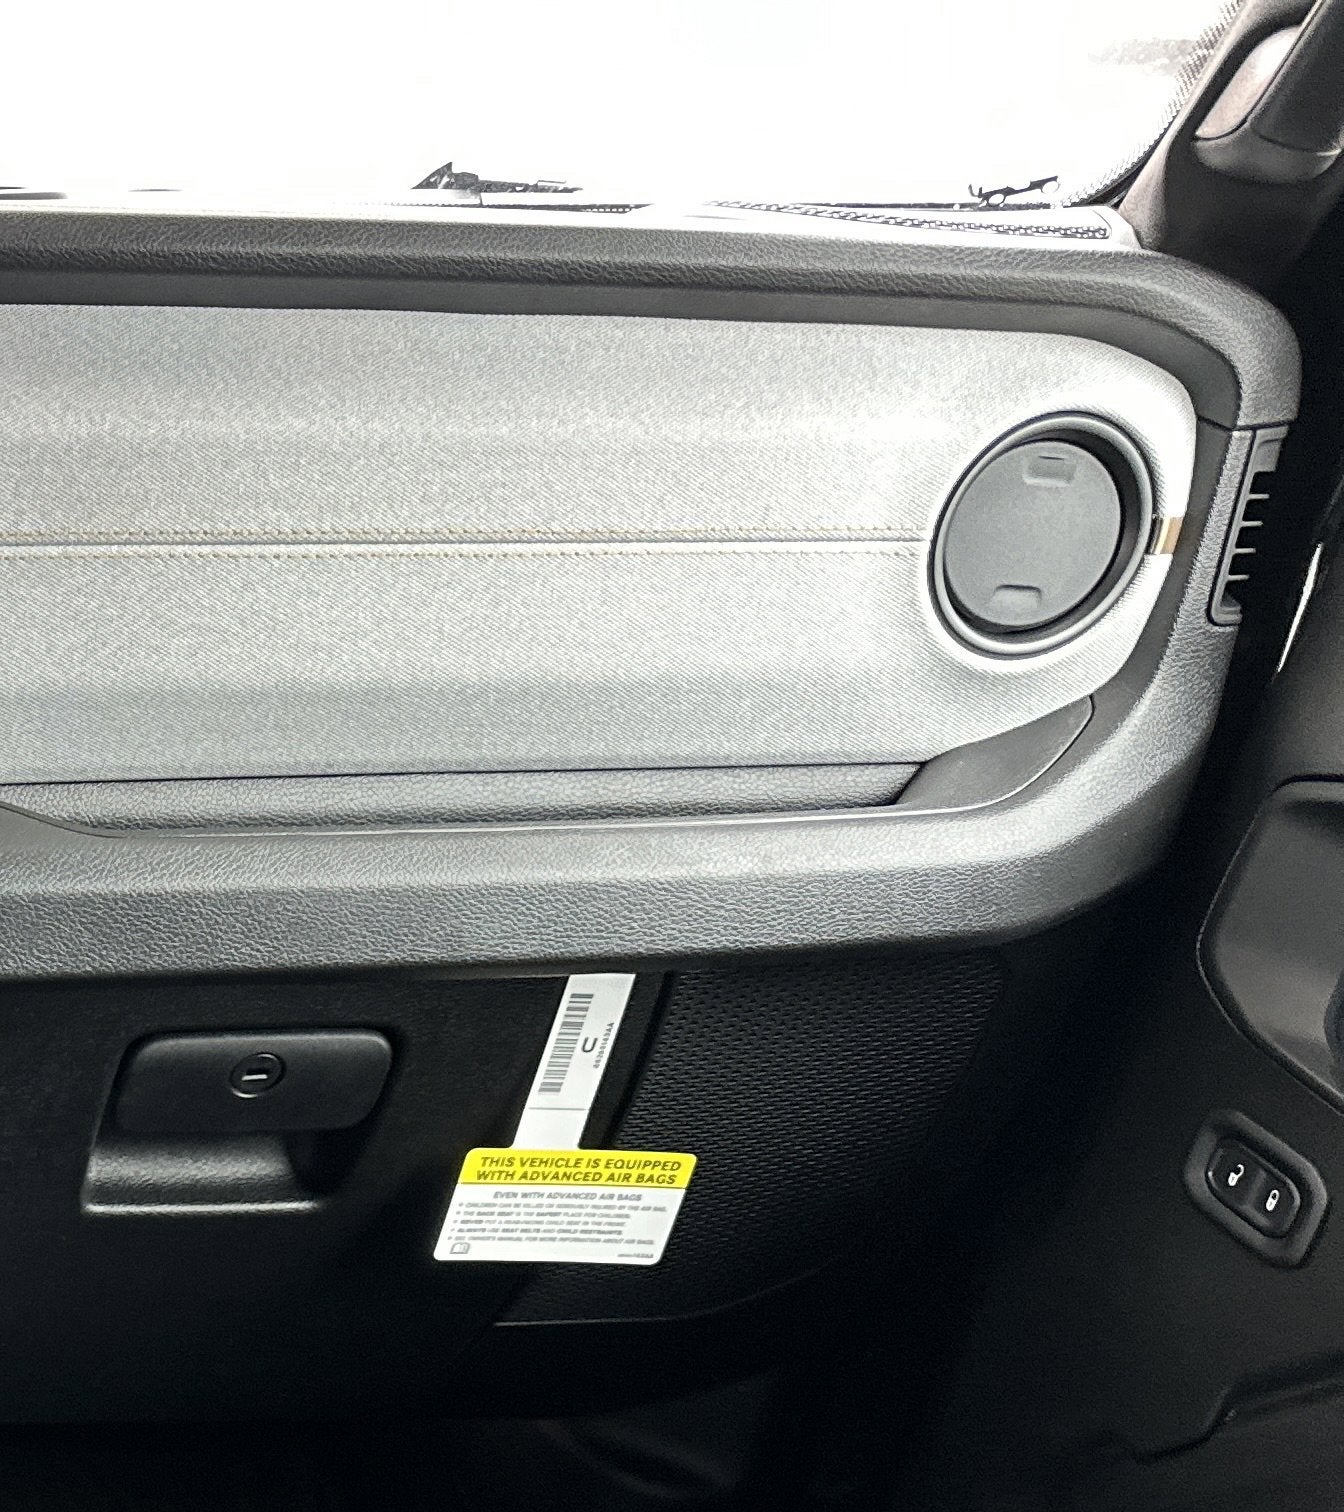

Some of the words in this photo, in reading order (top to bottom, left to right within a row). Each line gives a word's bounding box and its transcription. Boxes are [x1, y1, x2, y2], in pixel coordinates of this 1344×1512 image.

[582, 1036, 598, 1053] U
[481, 1156, 516, 1168] THIS
[519, 1156, 584, 1169] VEHICLE
[586, 1158, 602, 1169] IS
[604, 1158, 682, 1171] EQUIPPED
[476, 1170, 516, 1181] WITH
[518, 1170, 603, 1183] ADVANCED
[605, 1172, 633, 1184] AIR
[635, 1173, 678, 1185] BAGS
[493, 1191, 519, 1199] EVEN
[520, 1191, 546, 1199] WITH
[546, 1191, 598, 1200] ADVANCED
[598, 1193, 616, 1201] AIR
[616, 1193, 643, 1202] BAGS
